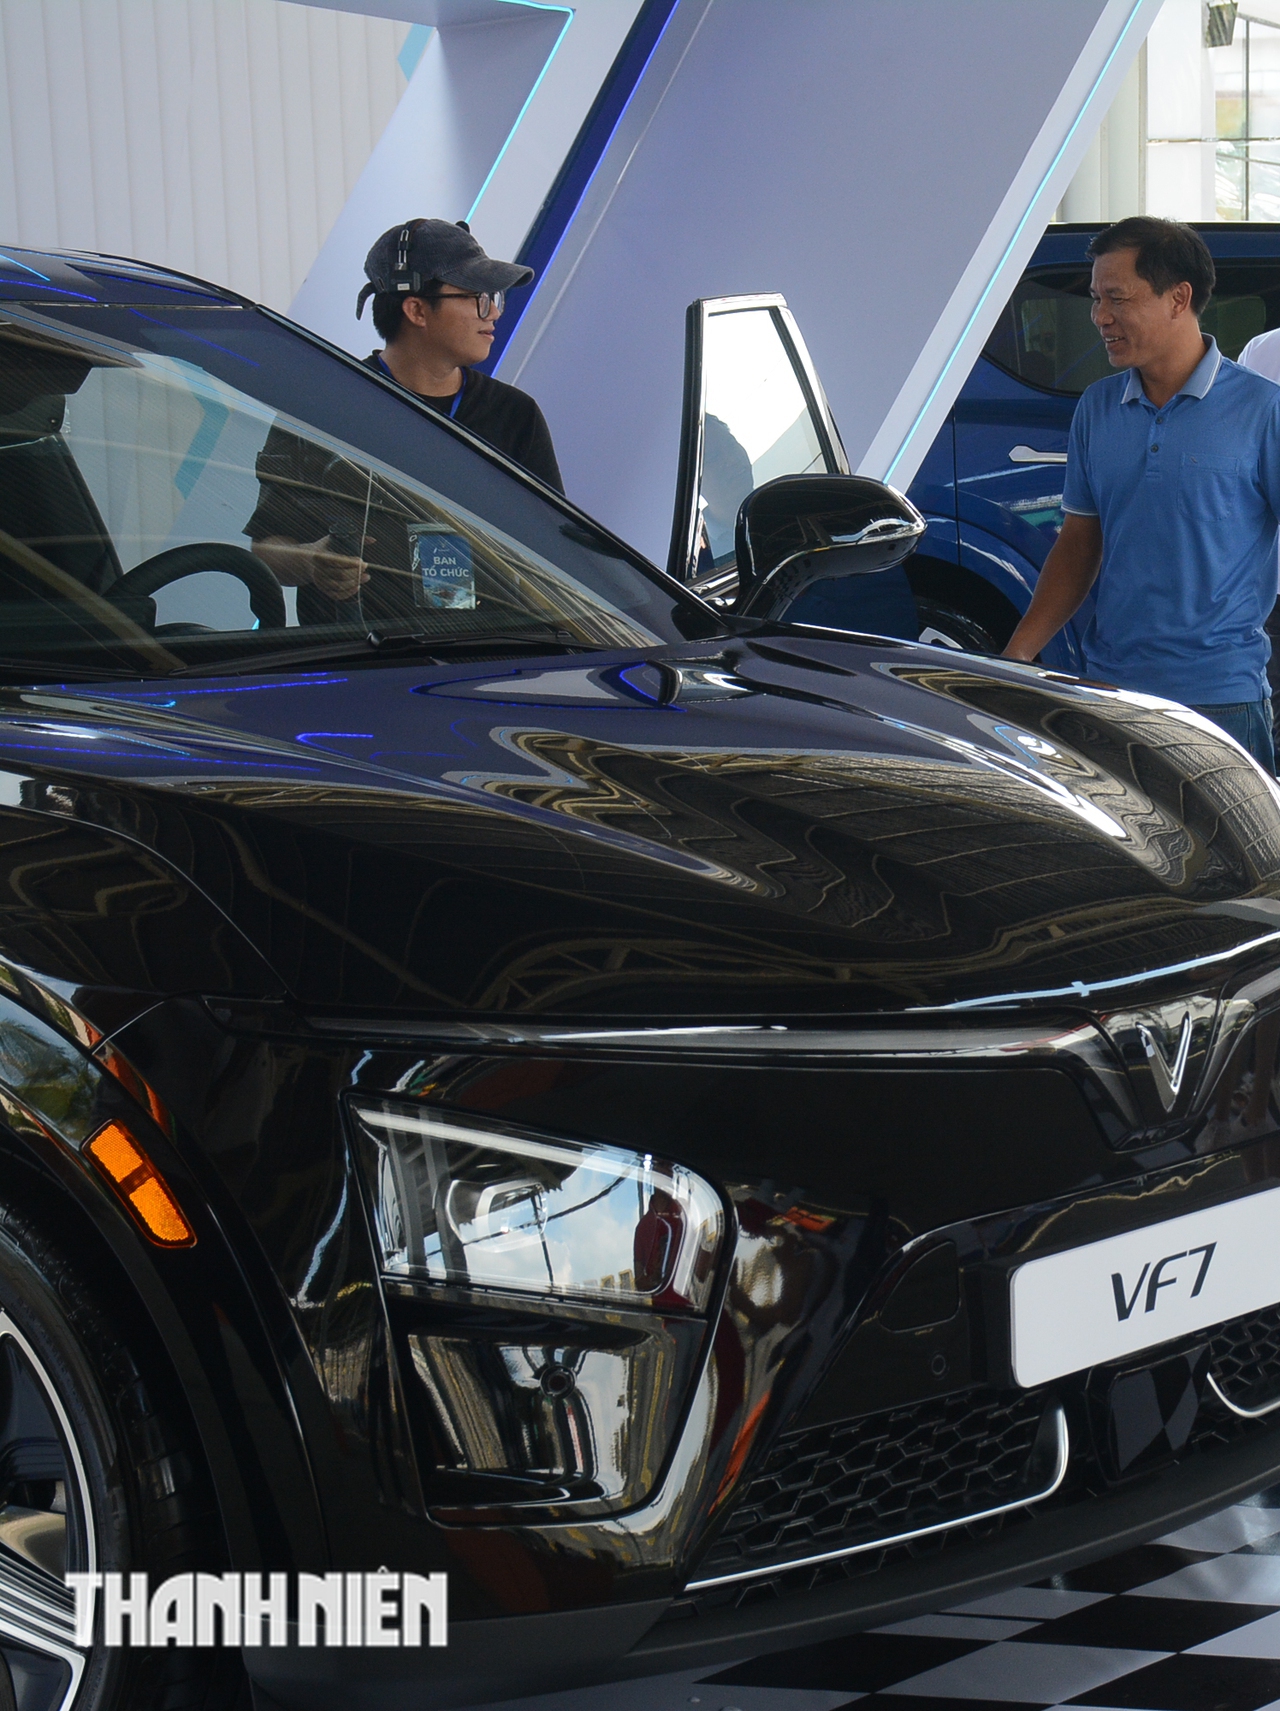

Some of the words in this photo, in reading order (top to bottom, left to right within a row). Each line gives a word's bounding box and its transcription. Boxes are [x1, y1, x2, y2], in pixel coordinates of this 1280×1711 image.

[433, 556, 456, 565] BAN
[440, 566, 469, 577] CHỨC
[1111, 1241, 1218, 1322] VF7
